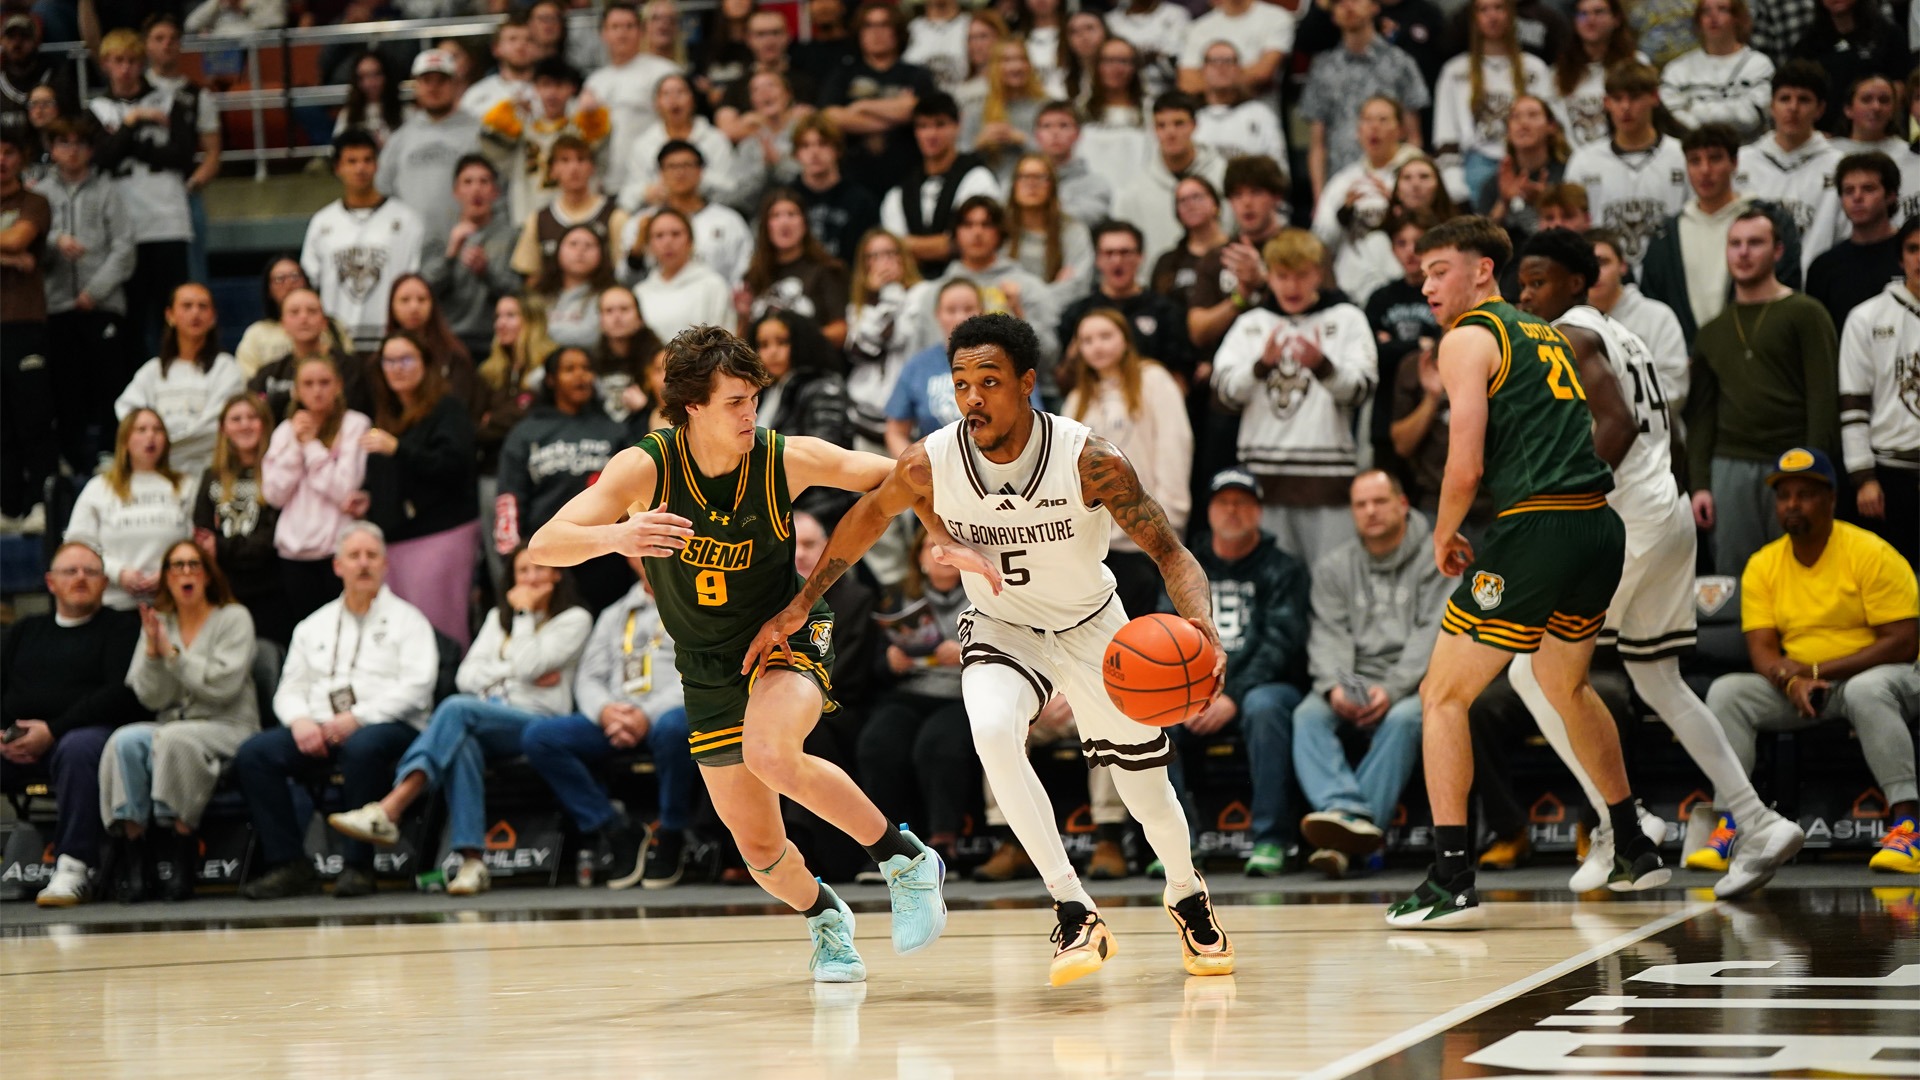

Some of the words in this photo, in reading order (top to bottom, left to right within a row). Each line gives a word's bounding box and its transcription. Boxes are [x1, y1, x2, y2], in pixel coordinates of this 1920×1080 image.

[1537, 345, 1587, 400] 21
[1626, 361, 1668, 433] 24
[948, 519, 970, 542] ST.
[969, 518, 1075, 546] BONAVENTURE
[682, 537, 752, 570] SIENA
[1000, 549, 1031, 587] 5
[695, 569, 728, 607] 9
[1805, 816, 1887, 840] ASHL
[443, 846, 551, 873] AHLEY
